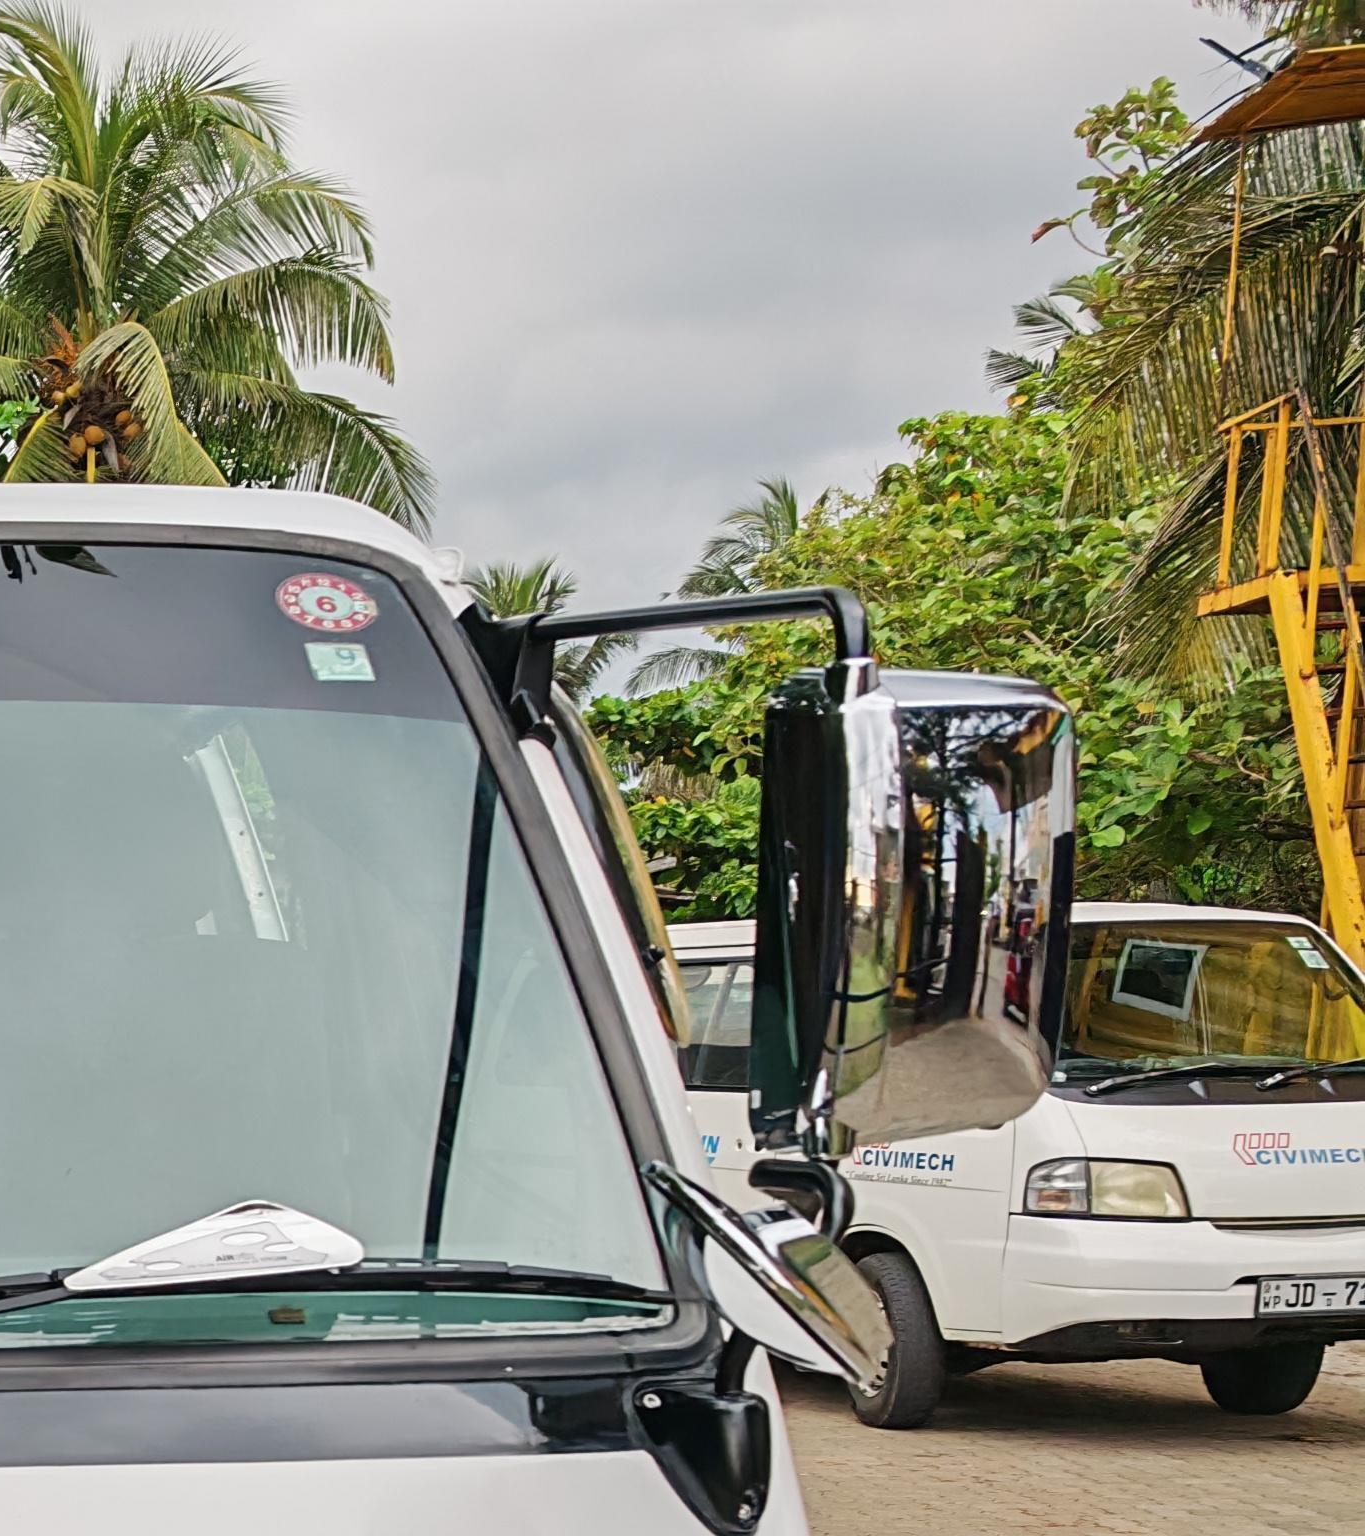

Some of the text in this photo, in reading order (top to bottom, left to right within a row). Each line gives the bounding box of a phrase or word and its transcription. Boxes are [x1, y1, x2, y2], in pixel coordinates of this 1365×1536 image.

[315, 596, 338, 614] 6
[862, 1149, 955, 1171] CIVIMECH
[1263, 1295, 1281, 1309] WP
[1284, 1283, 1316, 1308] JD
